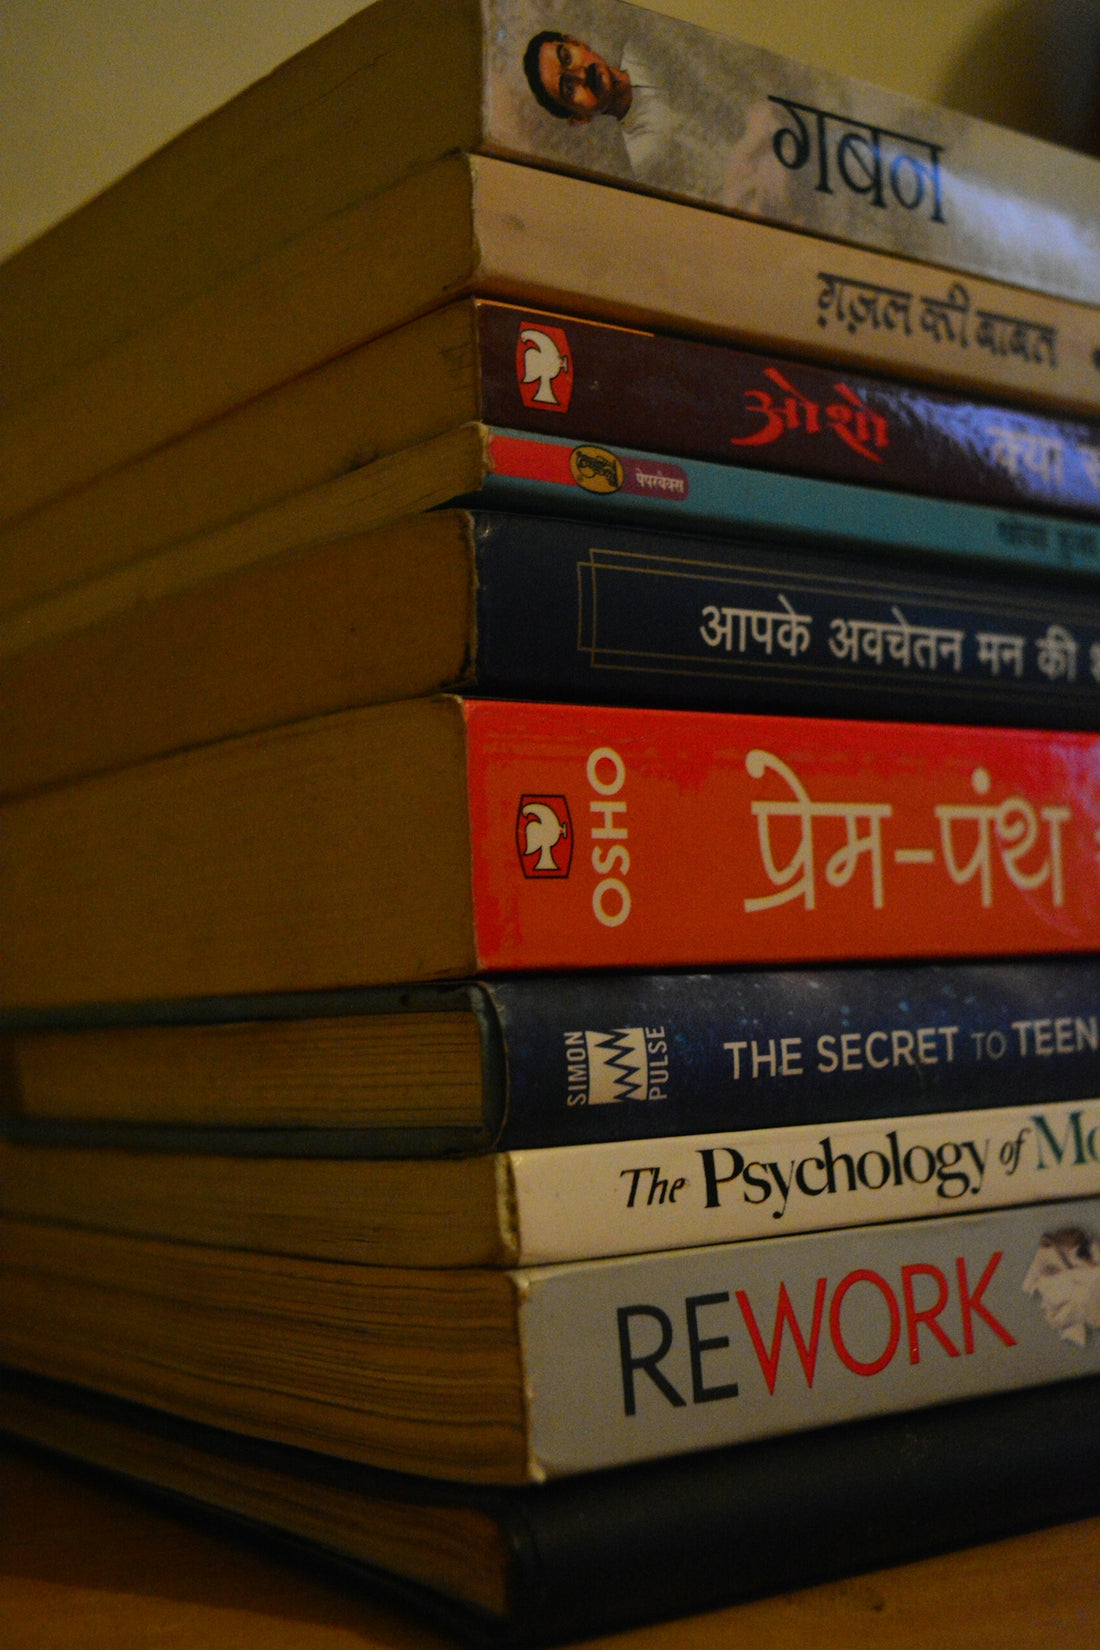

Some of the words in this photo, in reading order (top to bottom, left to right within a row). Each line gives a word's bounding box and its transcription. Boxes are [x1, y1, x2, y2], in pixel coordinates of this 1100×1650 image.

[768, 95, 946, 223] गबन
[817, 272, 913, 335] ग़ज़ल
[919, 282, 971, 348] की
[975, 309, 1059, 368] बाबत
[730, 367, 890, 463] ओशो
[700, 594, 813, 657] आपके
[828, 607, 965, 672] अवचेतन
[975, 632, 1025, 678] मन
[1034, 623, 1078, 683] की
[586, 747, 632, 928] OSHO
[743, 749, 1072, 914] प्रेम-पंथ
[563, 1031, 588, 1107] SIMON
[645, 1025, 669, 1101] PULSE
[723, 1036, 804, 1081] THE
[816, 1026, 961, 1073] SECRET
[970, 1029, 1008, 1061] TO
[1011, 1015, 1099, 1057] TEEN
[620, 1167, 688, 1208] The
[697, 1131, 990, 1219] Psychology
[999, 1127, 1032, 1176] of
[616, 1250, 1018, 1416] REWORK
